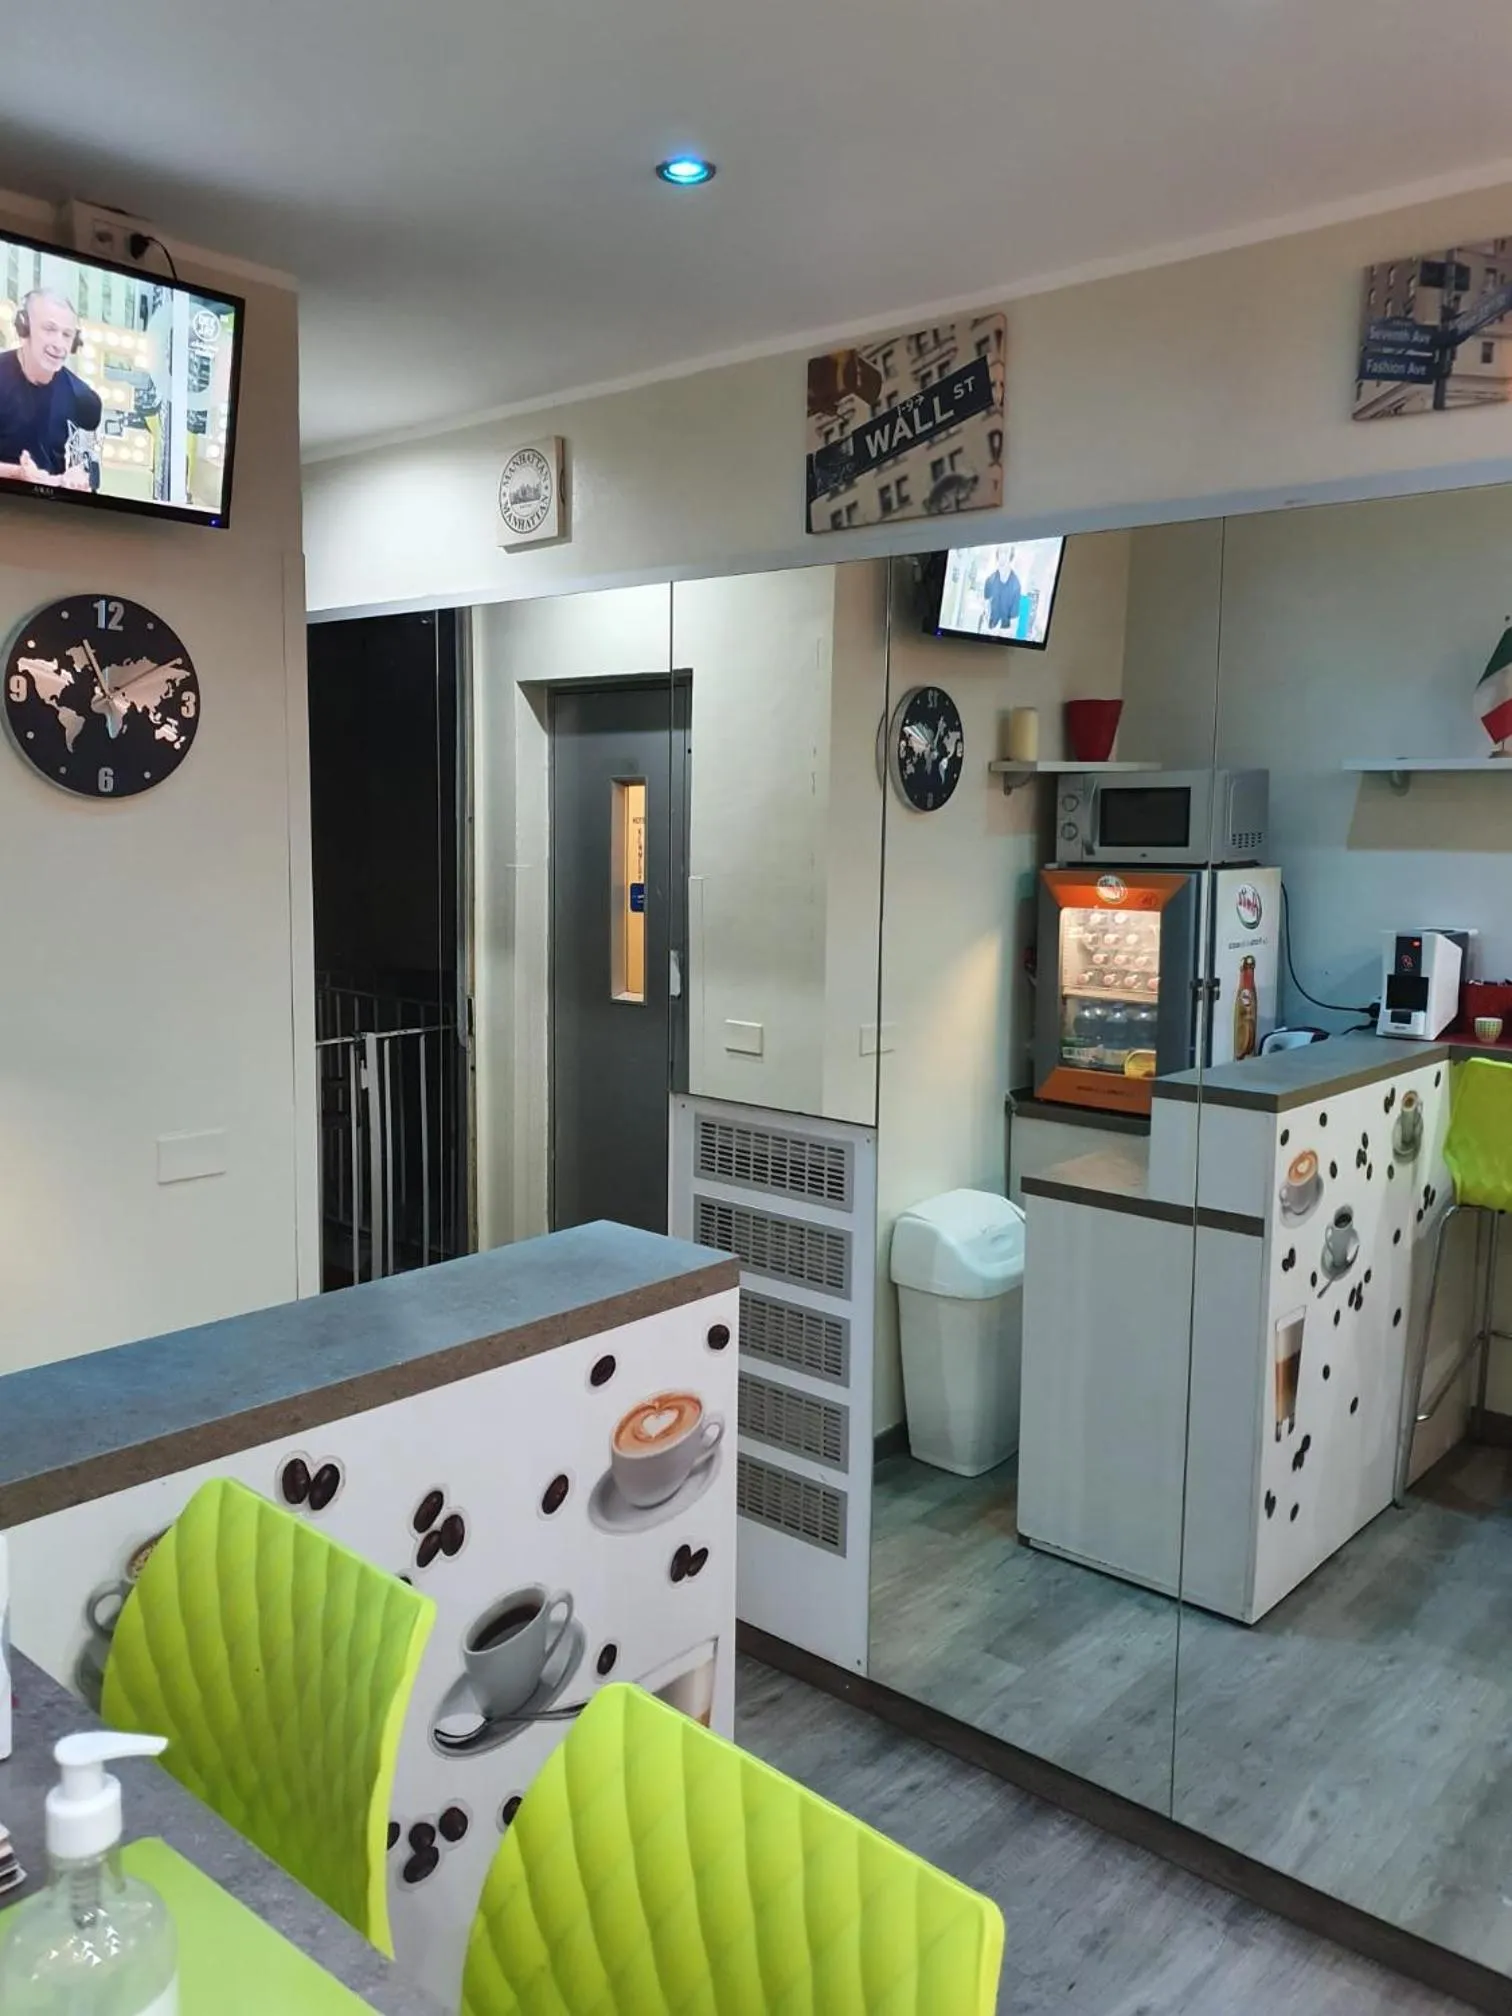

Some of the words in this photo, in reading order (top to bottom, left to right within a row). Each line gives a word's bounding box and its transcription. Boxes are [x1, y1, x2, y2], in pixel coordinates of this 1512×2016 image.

[865, 396, 955, 459] WALL
[952, 375, 976, 400] ST
[93, 599, 125, 631] 12
[9, 675, 28, 703] 9
[180, 691, 196, 719] 3
[98, 767, 114, 792] 6
